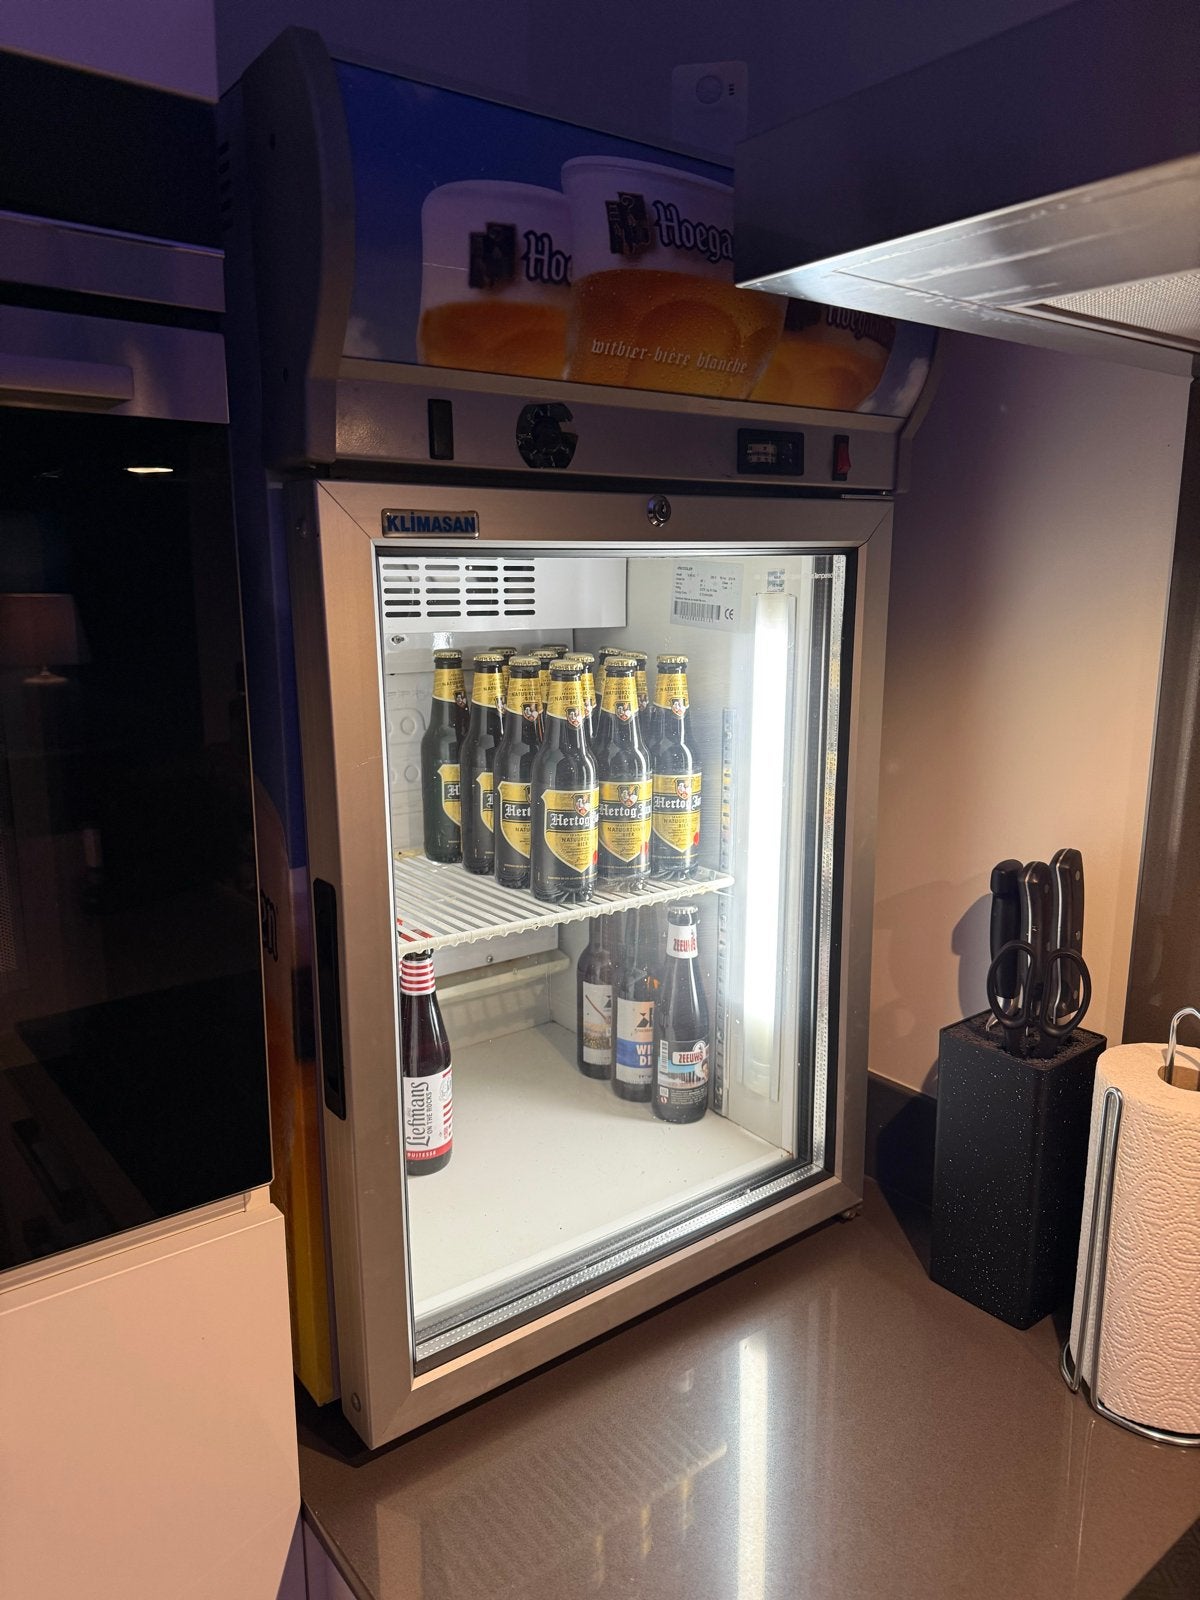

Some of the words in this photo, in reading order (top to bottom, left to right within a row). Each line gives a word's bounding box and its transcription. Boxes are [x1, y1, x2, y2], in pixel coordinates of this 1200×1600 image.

[697, 353, 749, 374] blanche
[600, 803, 638, 818] Hertog
[425, 1091, 433, 1112] ROCKS
[406, 1081, 430, 1147] Liefmans
[426, 1126, 433, 1135] ON
